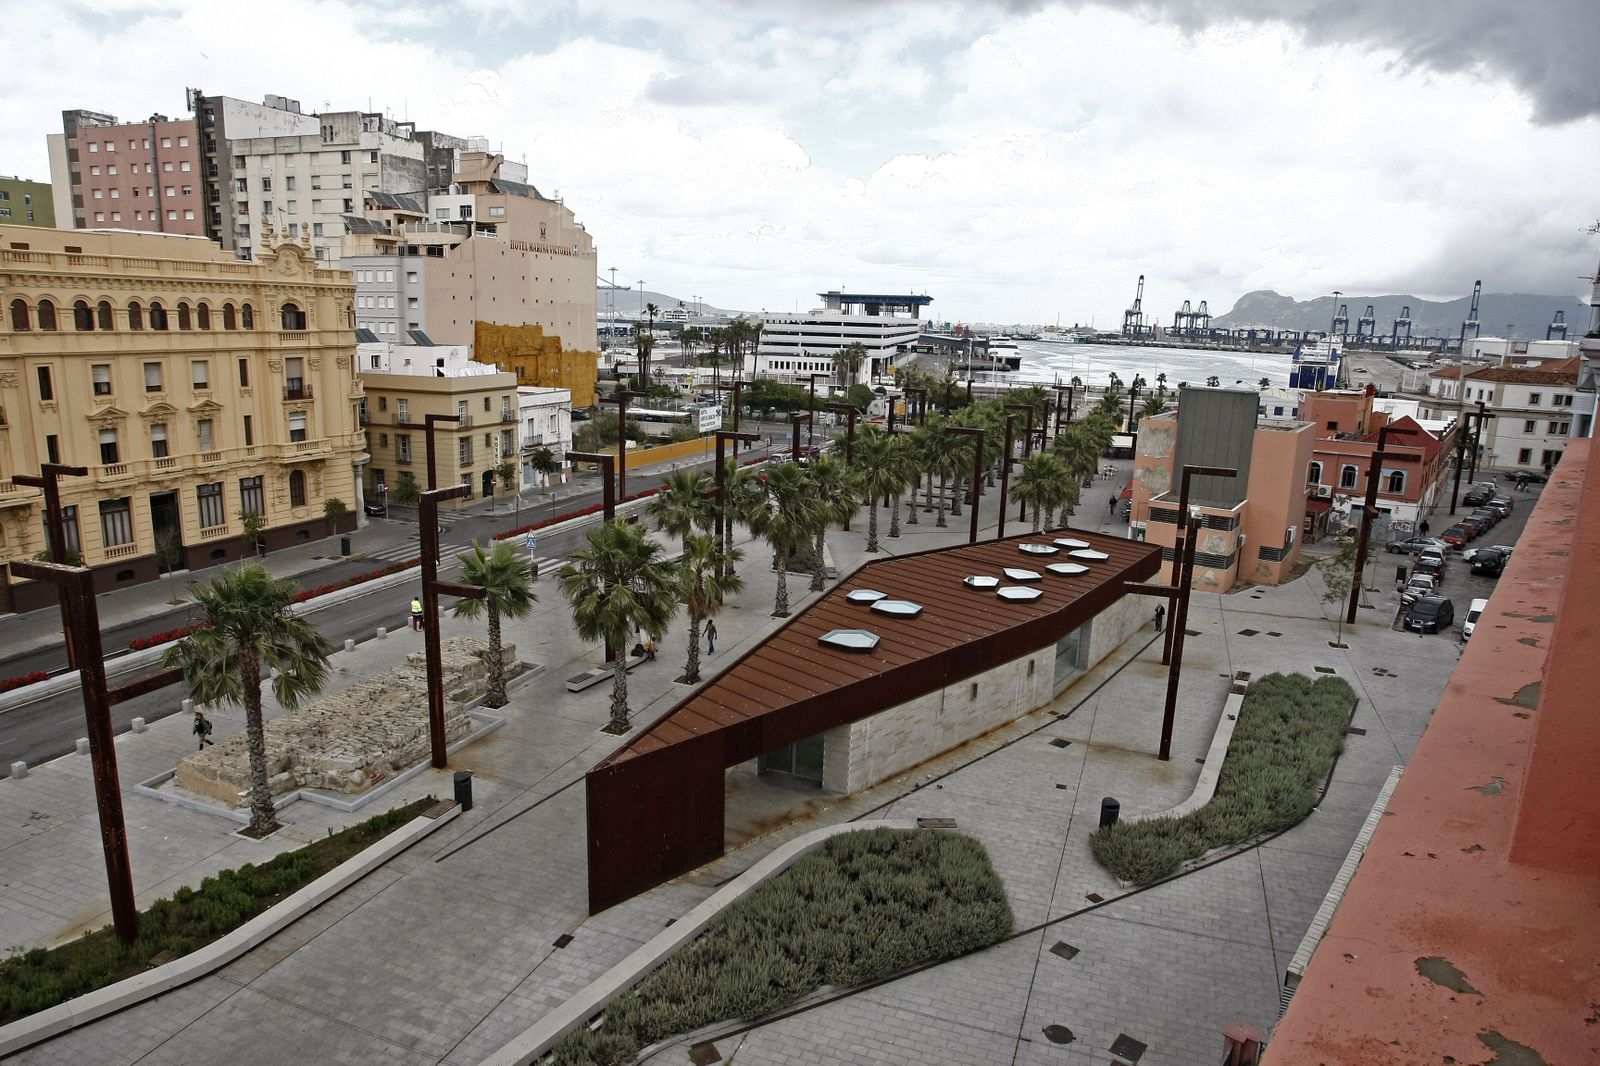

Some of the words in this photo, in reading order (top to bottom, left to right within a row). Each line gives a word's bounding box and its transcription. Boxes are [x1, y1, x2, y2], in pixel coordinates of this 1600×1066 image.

[510, 240, 528, 251] HOTEL
[528, 241, 549, 254] MARINA
[549, 244, 572, 256] VICTORIA
